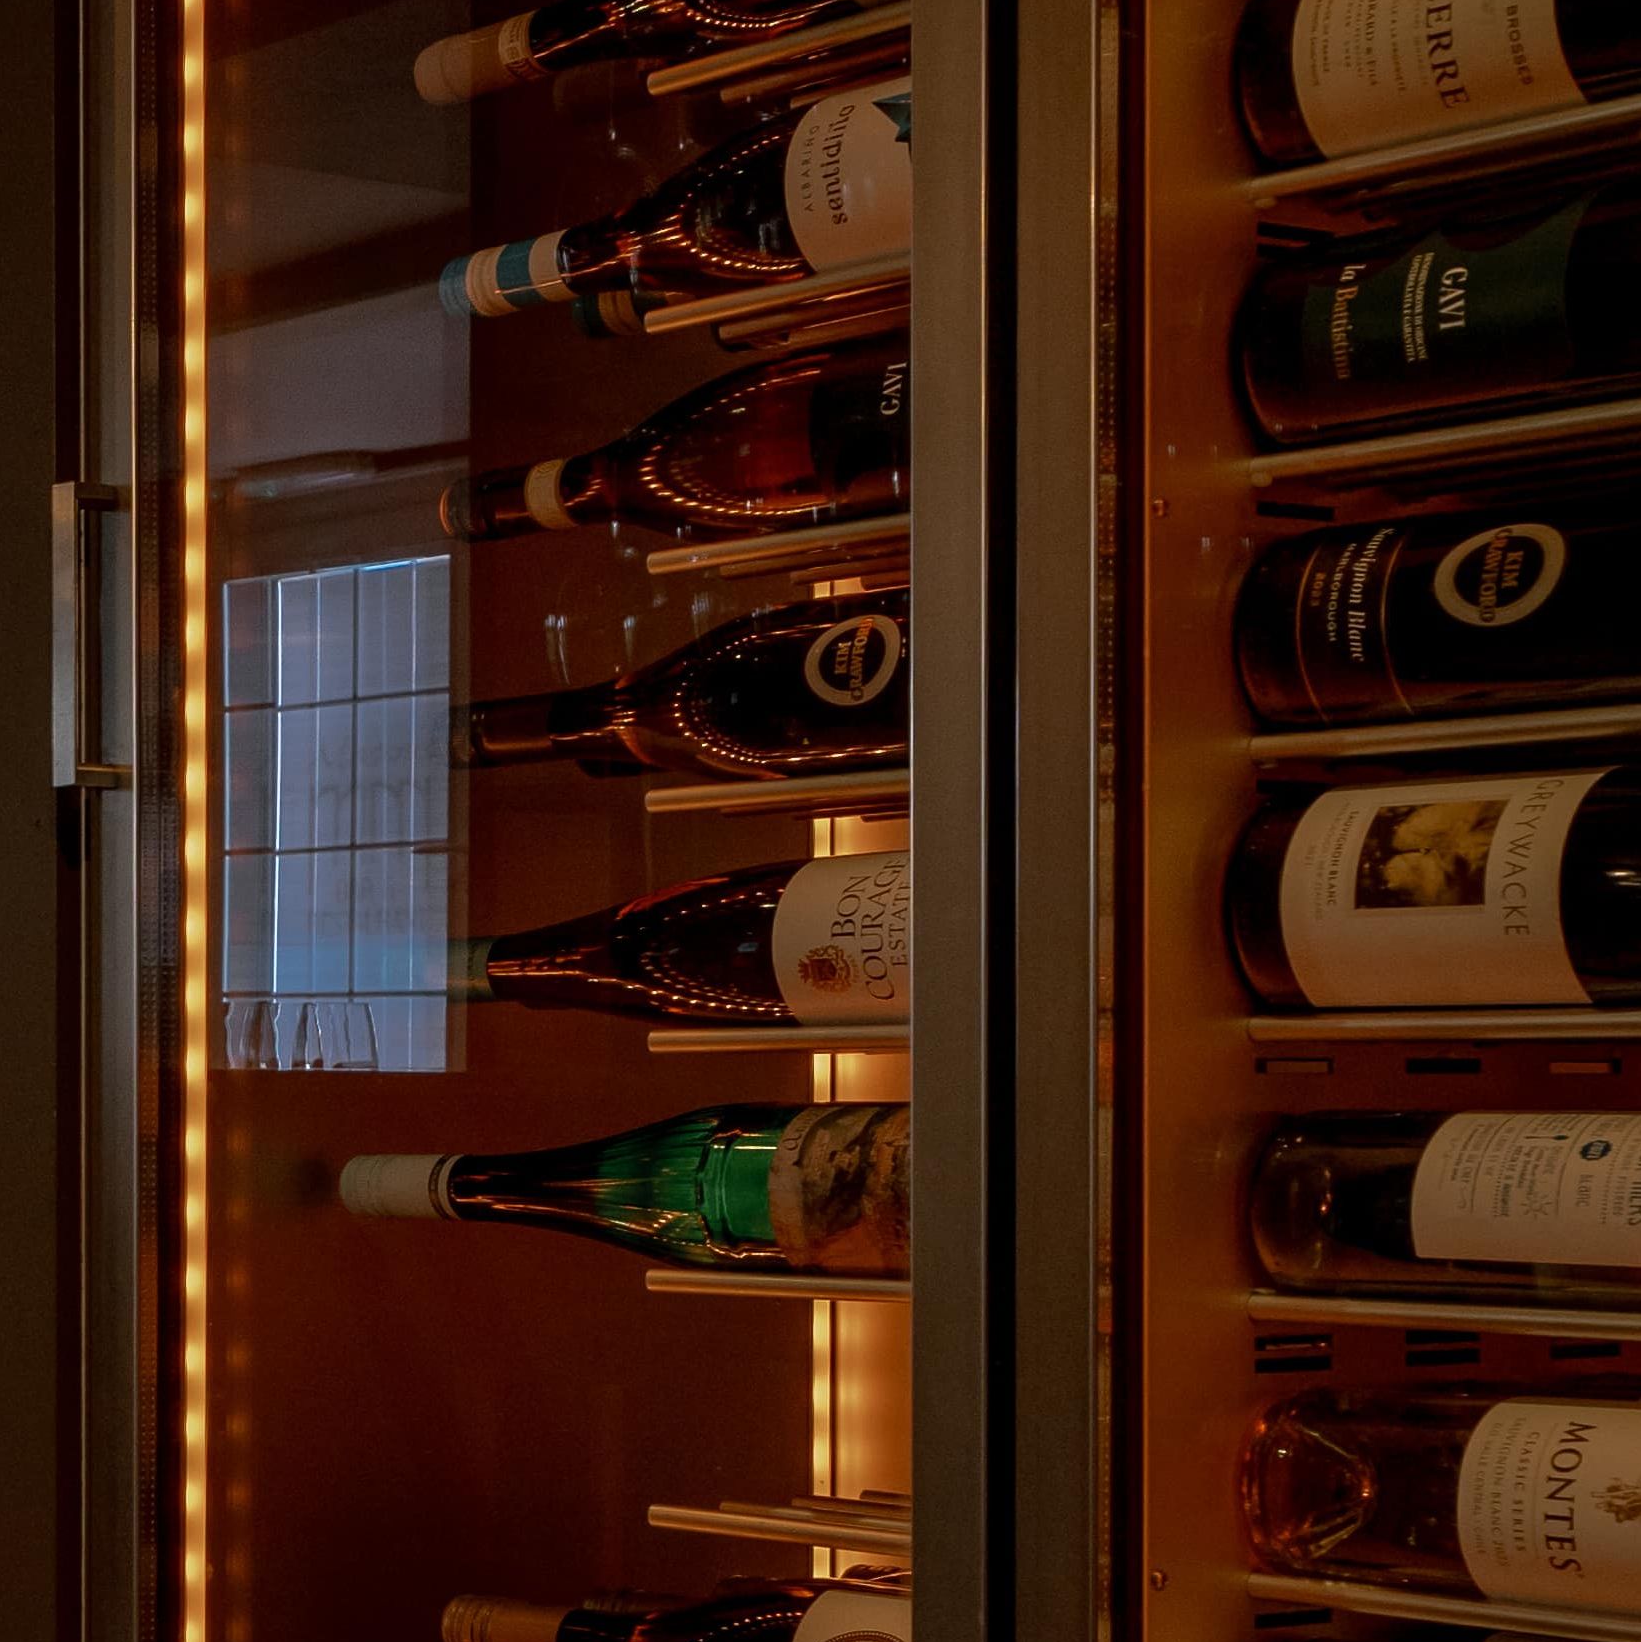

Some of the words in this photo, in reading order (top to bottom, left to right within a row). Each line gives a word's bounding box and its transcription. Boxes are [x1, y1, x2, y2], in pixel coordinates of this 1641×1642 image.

[1506, 5, 1533, 85] BROSSES
[1339, 263, 1366, 281] la
[1439, 266, 1467, 331] GAVI
[1330, 286, 1357, 378] Battistina
[878, 360, 906, 415] GAVI
[1326, 543, 1355, 641] MARLBOROUGH
[1349, 527, 1395, 603] Sauvignon
[1478, 530, 1511, 621] CRAWFORD
[1501, 550, 1523, 589] KIM
[834, 641, 850, 674] KIM
[1347, 609, 1365, 662] Blanc
[1328, 810, 1359, 867] SAUVIGNON
[1503, 778, 1564, 936] GREYWACKE
[831, 876, 870, 937] BON
[1327, 870, 1337, 905] BLANC
[860, 860, 904, 999] COURAGE
[1491, 1416, 1524, 1487] SAUVIGNON
[1513, 1431, 1540, 1491] CLASSIC
[1490, 1491, 1501, 1535] BLANC
[1513, 1499, 1526, 1551] SERIES
[1543, 1421, 1596, 1572] MONTES
